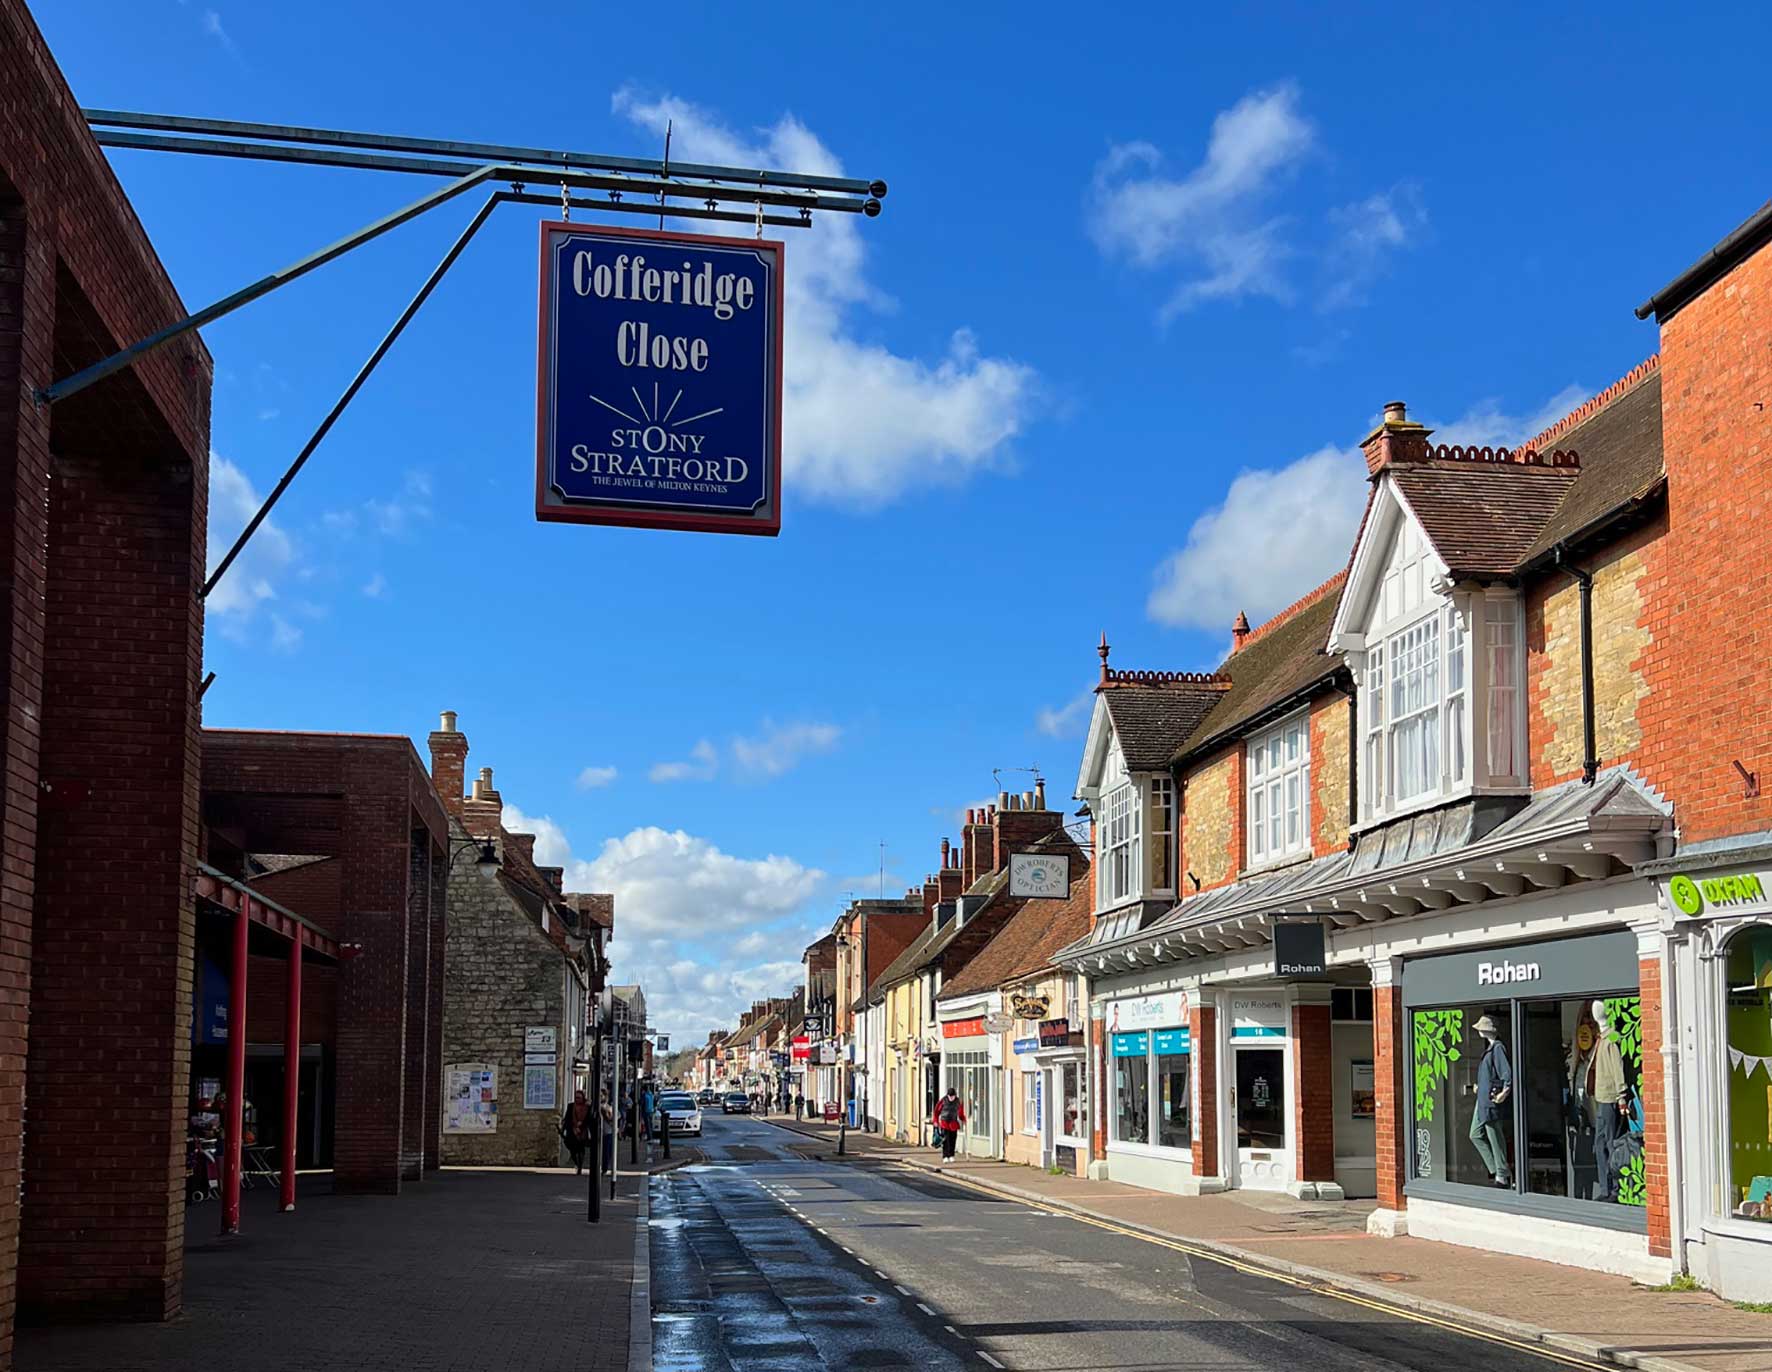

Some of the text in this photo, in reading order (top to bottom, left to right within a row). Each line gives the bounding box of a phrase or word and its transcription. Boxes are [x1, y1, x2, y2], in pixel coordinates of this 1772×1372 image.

[573, 250, 754, 320] Cofferidge
[617, 320, 709, 372] Close
[611, 426, 705, 454] STONY
[570, 444, 748, 482] STRATFORD
[592, 476, 728, 493] THE JEWEL OF MILTON KEYNES
[1701, 873, 1762, 903] OXFAM
[1281, 963, 1321, 973] Rohan
[1478, 960, 1541, 985] Rohan
[1234, 1000, 1282, 1009] DW Roberts
